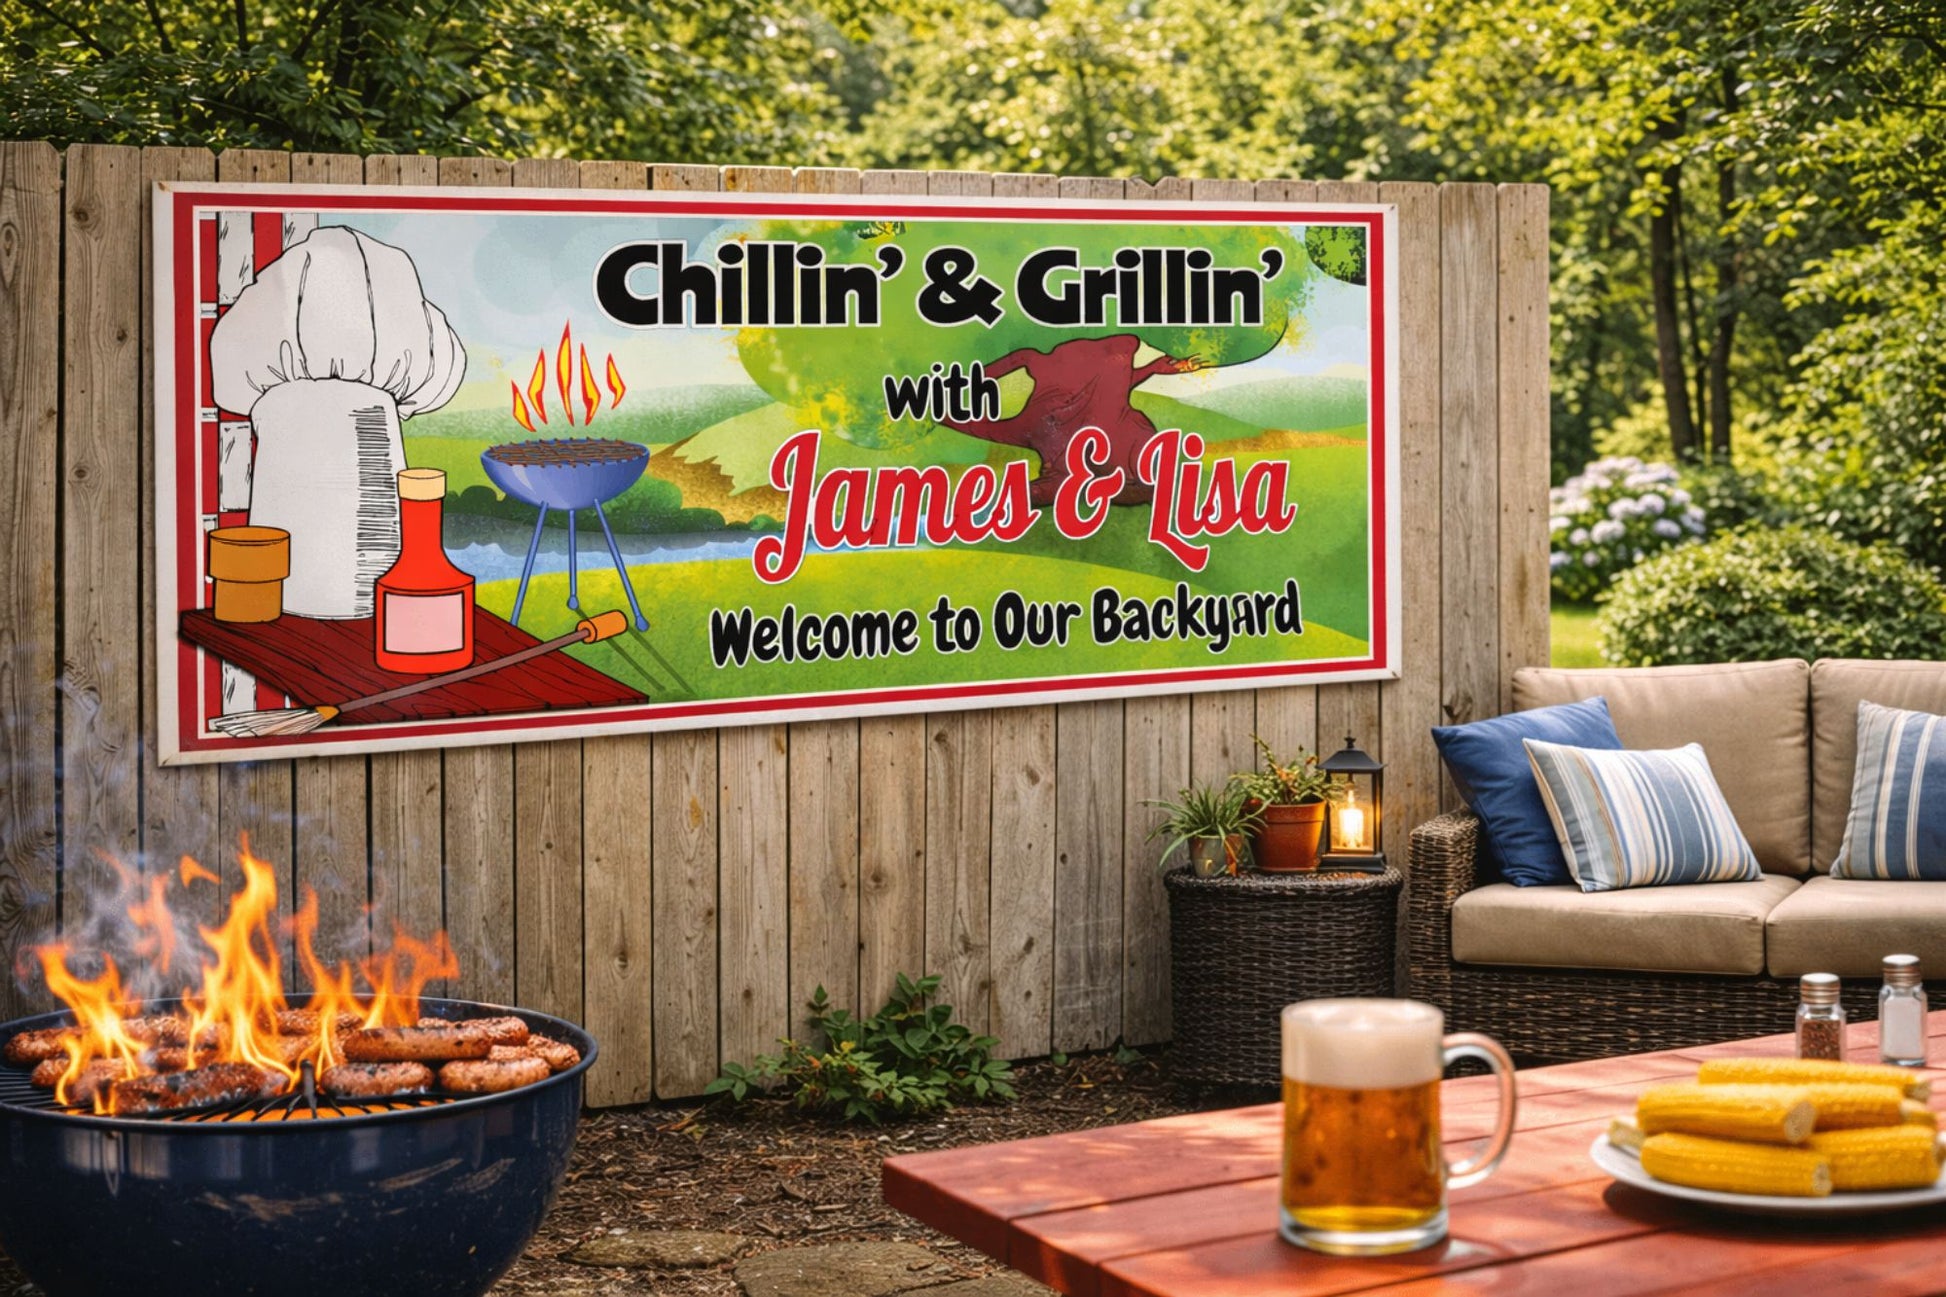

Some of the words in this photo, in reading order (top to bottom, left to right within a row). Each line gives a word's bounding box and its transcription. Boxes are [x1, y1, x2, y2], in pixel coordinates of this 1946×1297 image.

[594, 241, 904, 327] Chillin'
[916, 246, 1004, 328] &
[1016, 247, 1284, 327] Grillin'
[884, 361, 1000, 422] with
[753, 430, 1040, 584] James
[1054, 426, 1125, 540] &
[1138, 429, 1297, 571] Lisa
[710, 603, 919, 667] Welcome
[929, 596, 981, 653] to
[993, 590, 1082, 649] Our
[1092, 578, 1303, 653] Backyard
